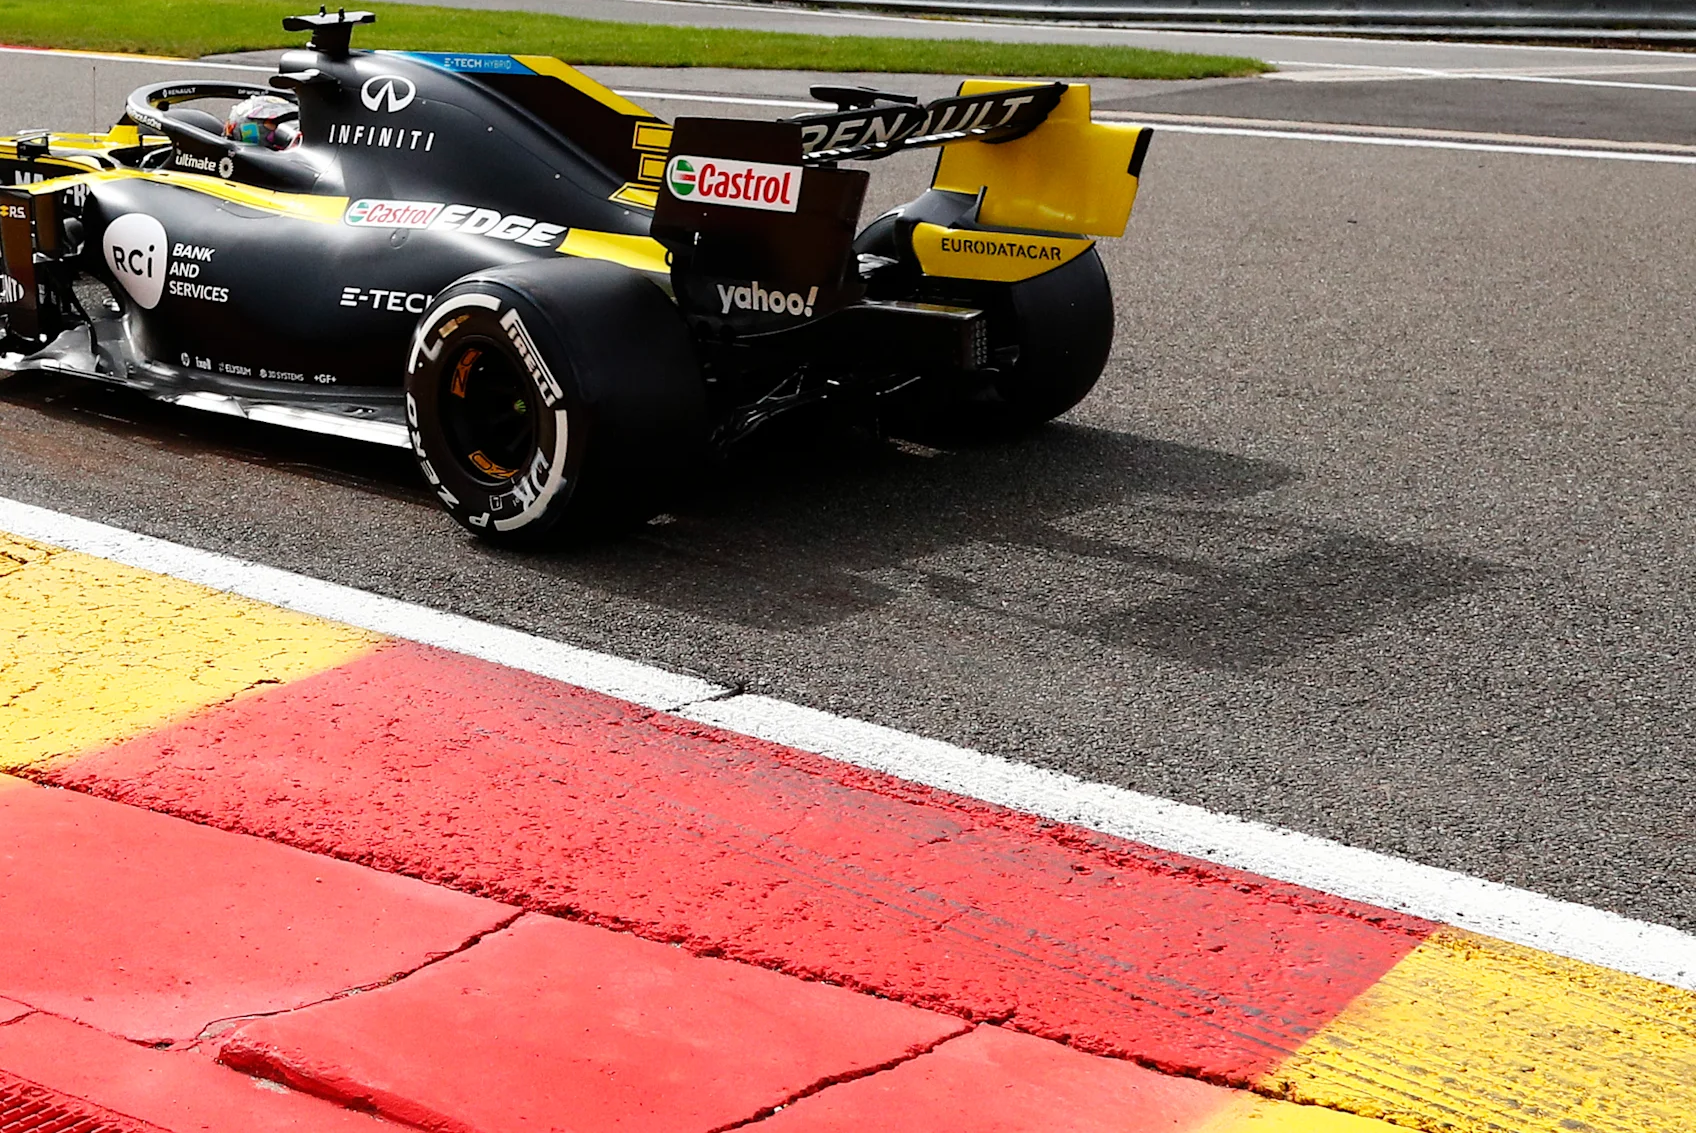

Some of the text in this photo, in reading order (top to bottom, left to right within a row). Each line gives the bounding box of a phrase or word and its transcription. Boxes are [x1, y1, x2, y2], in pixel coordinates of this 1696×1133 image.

[443, 57, 512, 70] E-TECH HYBRID
[328, 123, 435, 152] INFINITI
[175, 152, 217, 172] ultimate
[697, 162, 791, 206] Castrol
[366, 203, 568, 248] Castrol EDGE
[172, 242, 216, 262] BANK
[940, 236, 1062, 262] EURODATACAR
[169, 261, 200, 279] AND
[168, 280, 230, 303] SERVICES
[340, 286, 434, 314] E-TEC
[716, 280, 820, 318] yahoo!
[499, 308, 564, 408] PIRELLI
